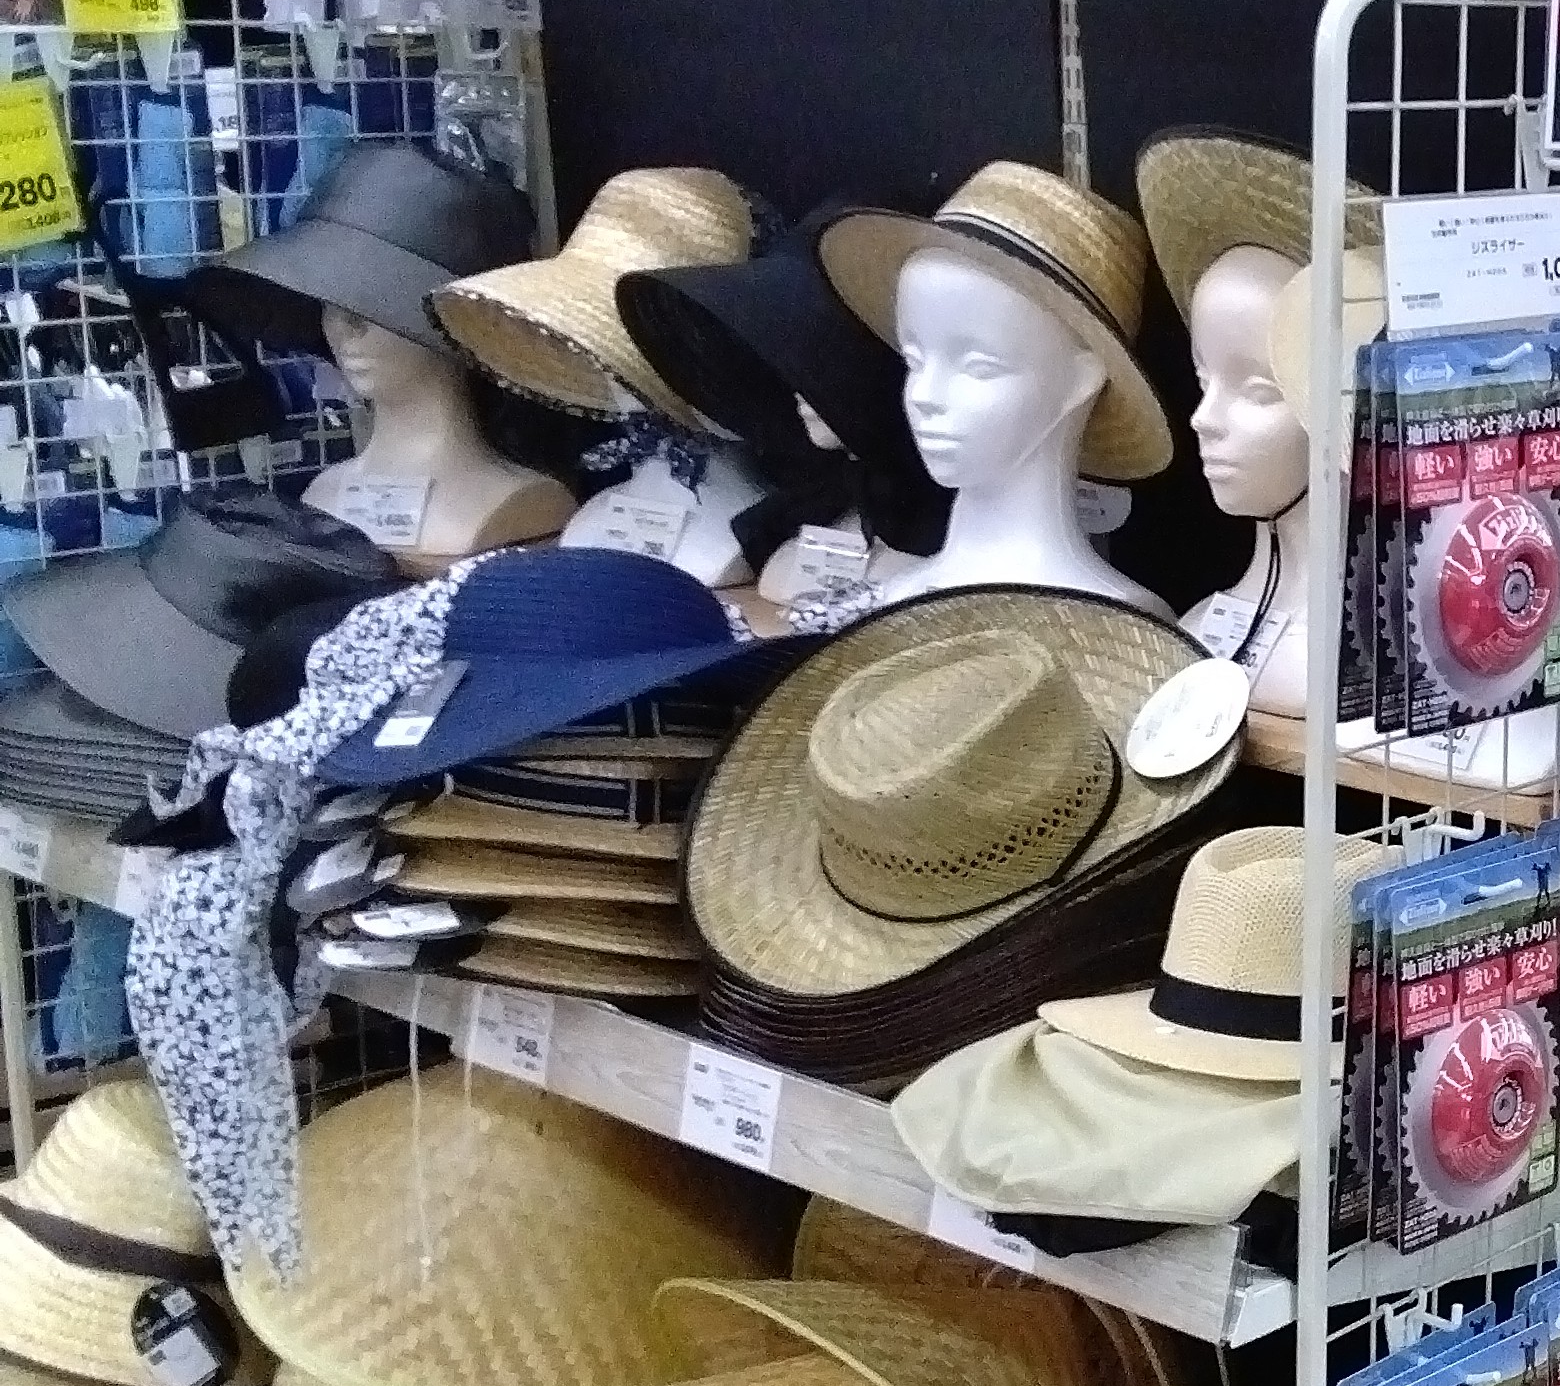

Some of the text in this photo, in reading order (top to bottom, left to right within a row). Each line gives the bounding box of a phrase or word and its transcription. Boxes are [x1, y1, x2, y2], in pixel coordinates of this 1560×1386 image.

[1413, 451, 1455, 480] 軽い
[1473, 444, 1513, 471] 強い
[1516, 948, 1553, 979] 安心
[1407, 983, 1447, 1013] 軽い
